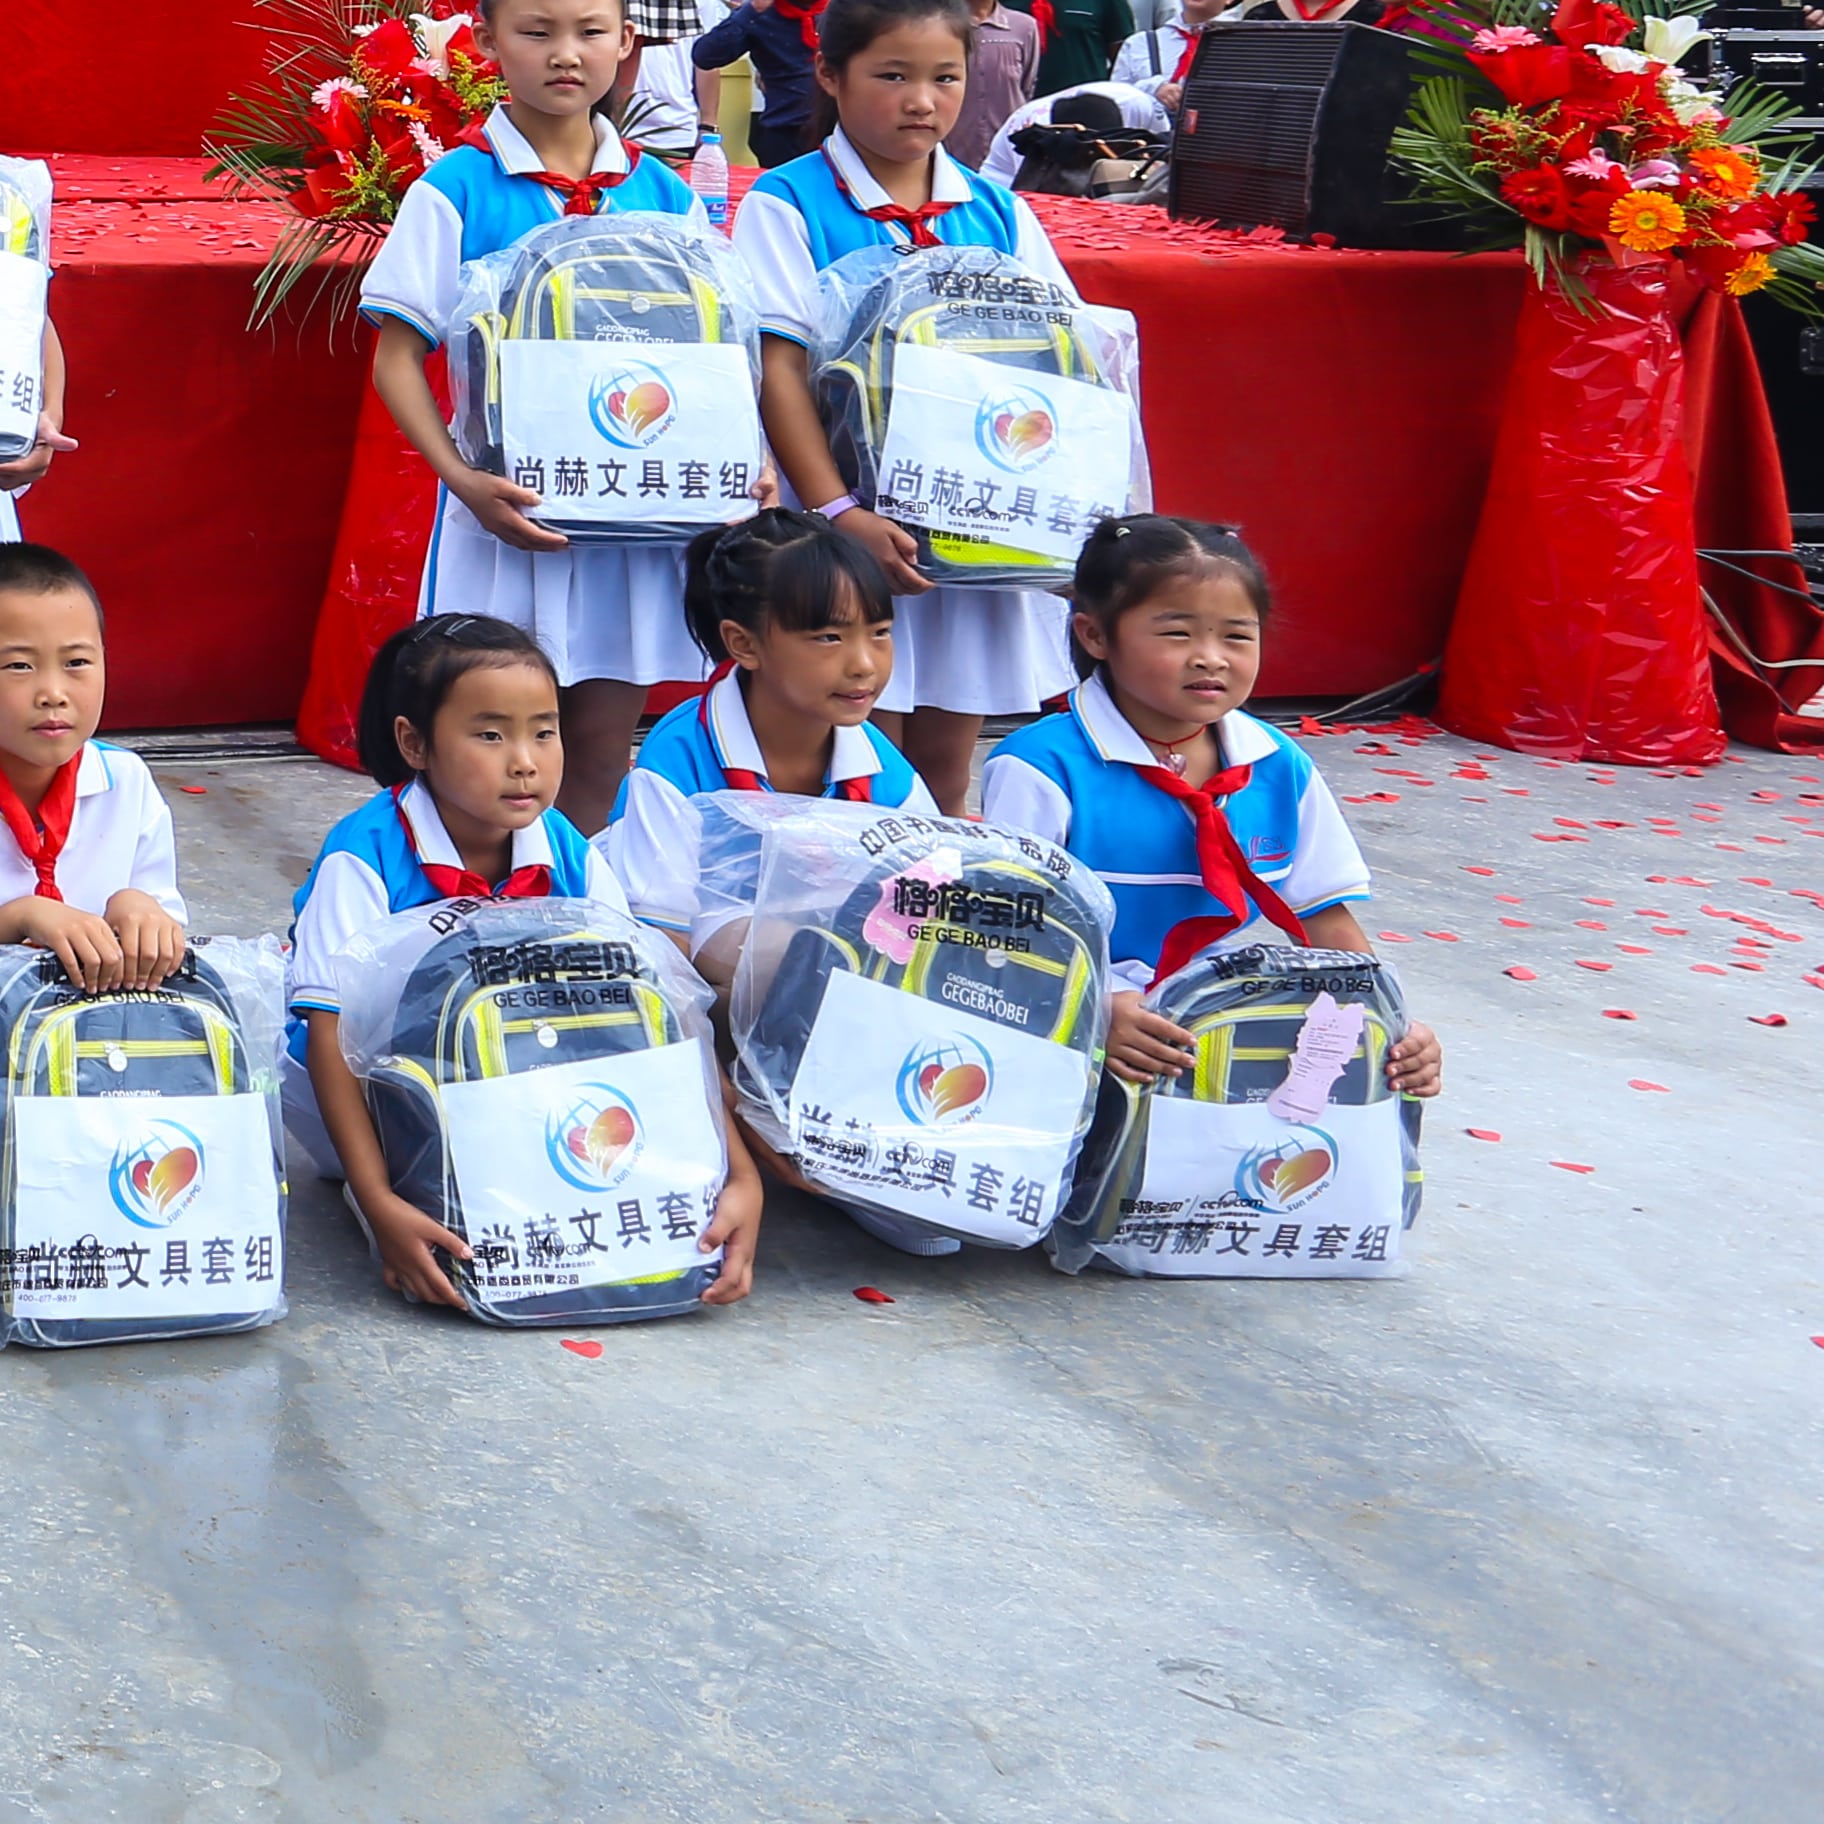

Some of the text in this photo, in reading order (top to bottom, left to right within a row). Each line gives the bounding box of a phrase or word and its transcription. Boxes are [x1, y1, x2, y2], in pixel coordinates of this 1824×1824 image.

[948, 303, 1073, 327] GE GE BAO BEI
[515, 456, 750, 500] 尚赫文具套组
[858, 817, 1073, 881] 中国书包第一品牌
[893, 876, 1046, 934] 格格宝贝
[907, 924, 1031, 954] GE GE BAO BEI
[469, 941, 640, 985] 格格宝贝
[1300, 977, 1343, 993] BAO
[1346, 977, 1375, 993] BEI
[493, 987, 632, 1008] GE GE BAO BEI
[942, 982, 1029, 1026] GEGEBAOBEI
